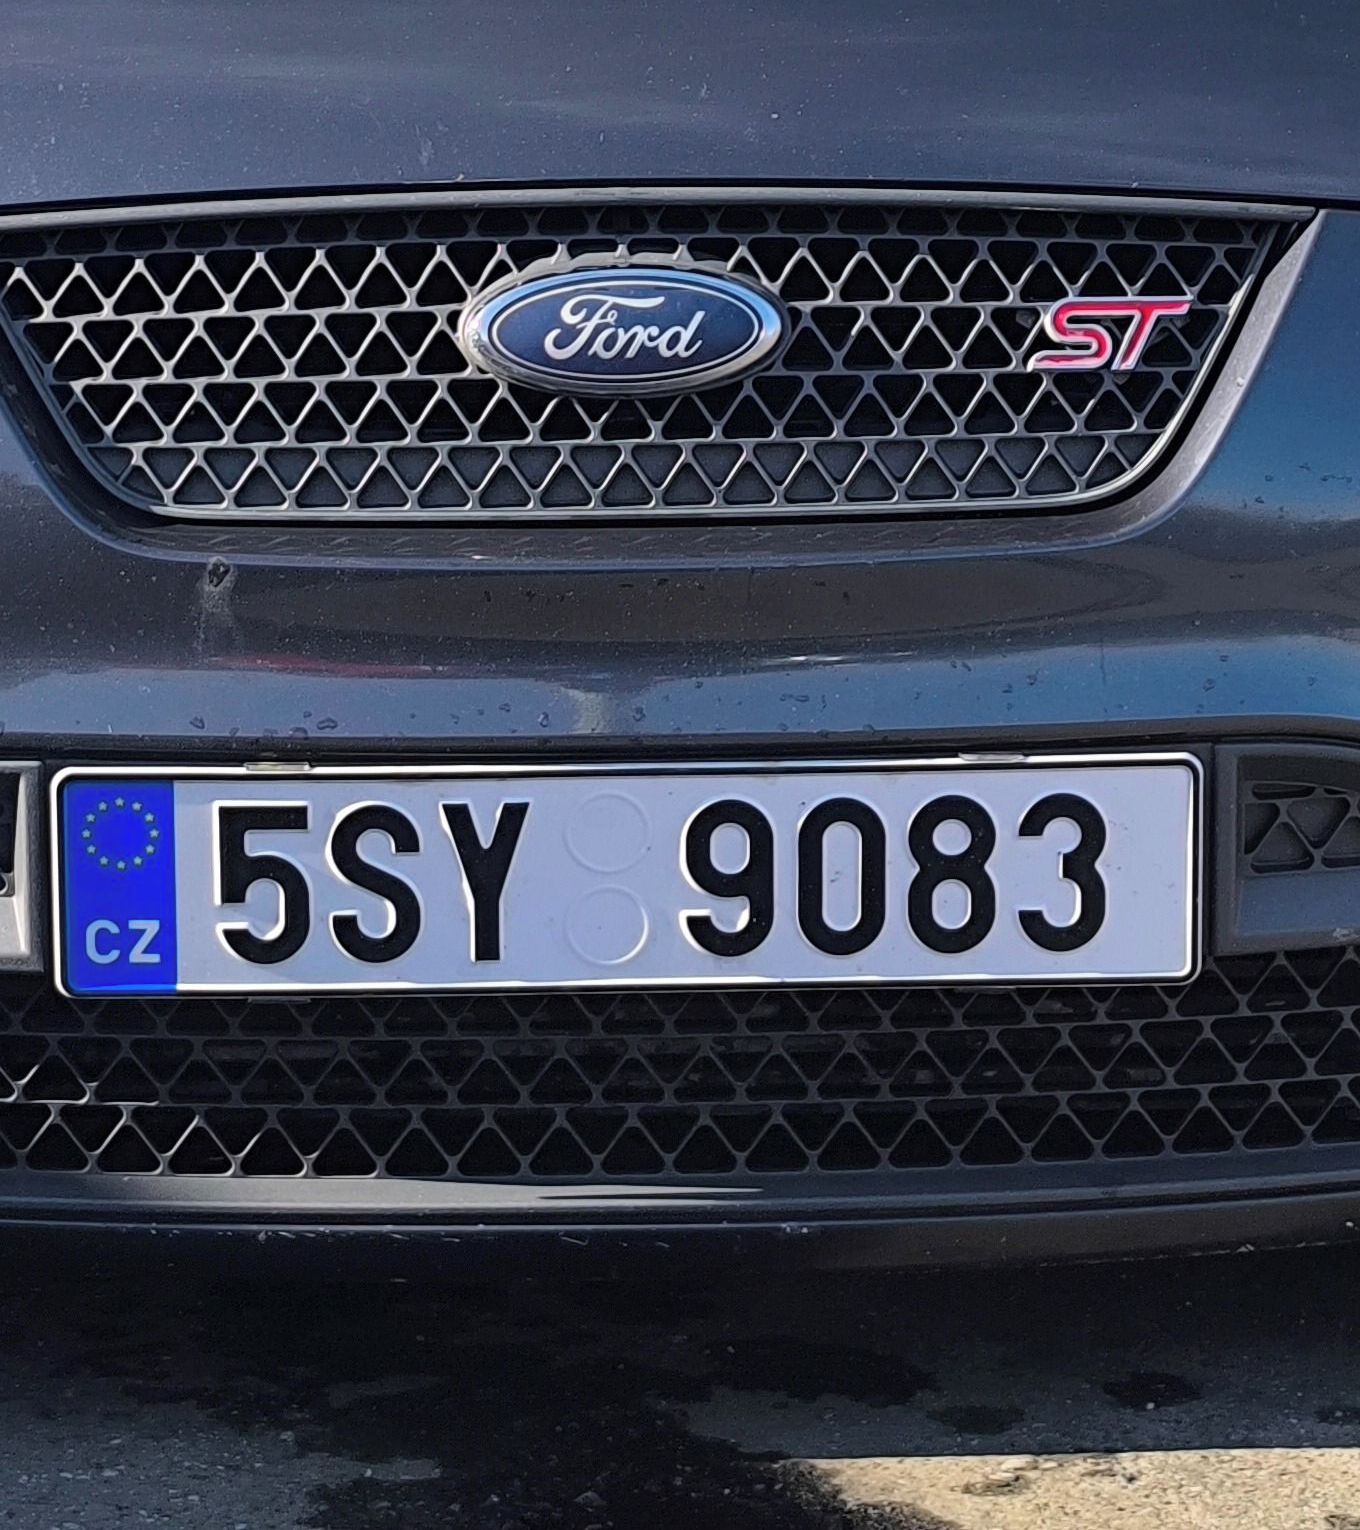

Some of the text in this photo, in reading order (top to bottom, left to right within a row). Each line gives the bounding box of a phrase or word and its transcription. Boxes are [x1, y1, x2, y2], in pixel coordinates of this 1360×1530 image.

[544, 294, 703, 362] Ford
[1027, 296, 1194, 371] ST
[214, 793, 1108, 965] 5SY 9083
[84, 918, 162, 966] CZ
